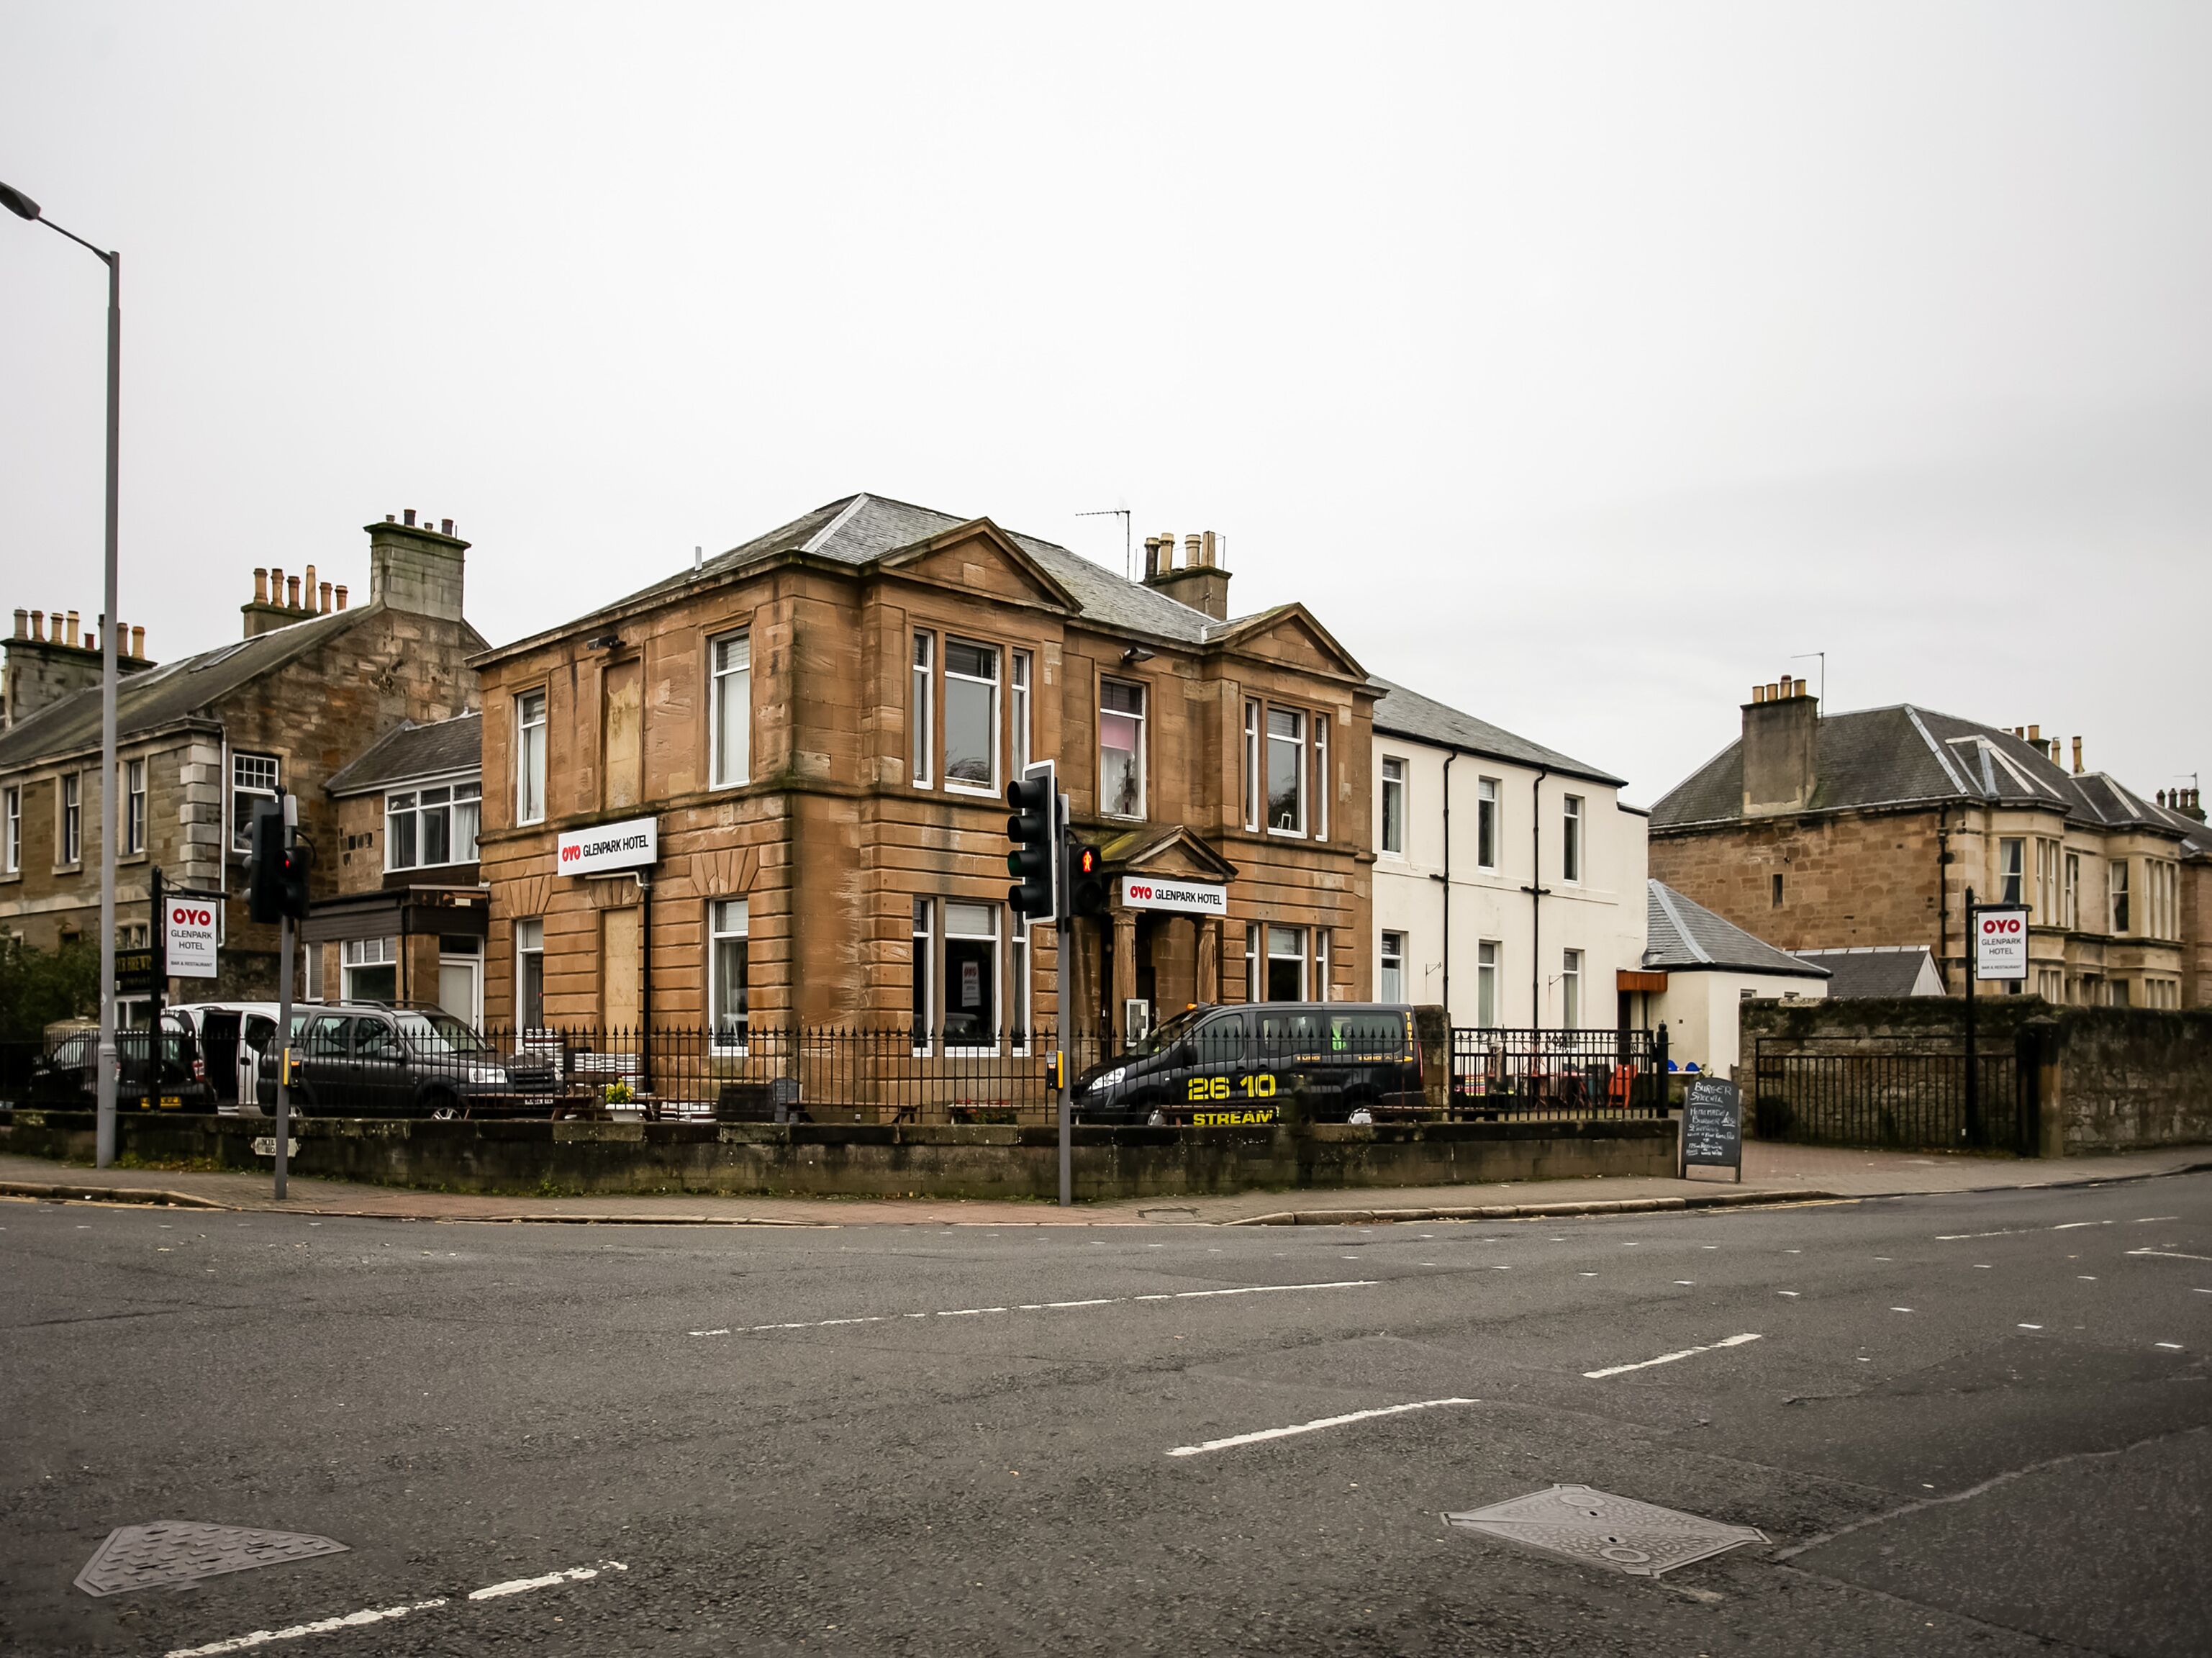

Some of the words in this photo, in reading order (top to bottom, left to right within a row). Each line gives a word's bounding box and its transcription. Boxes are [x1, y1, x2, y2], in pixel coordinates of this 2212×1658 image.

[561, 845, 581, 862] OYO
[583, 838, 622, 857] GLENPARK
[622, 835, 648, 851] HOTEL
[1130, 886, 1152, 900] OYO
[1155, 889, 1196, 902] GLENPARK
[1197, 893, 1222, 905] HOTEL
[173, 908, 211, 926] OYO
[171, 929, 212, 939] GLENPARK
[1983, 919, 2020, 934] OYO
[178, 941, 205, 951] HOTEL
[1188, 1077, 1230, 1100] 26
[1240, 1074, 1276, 1097] 10
